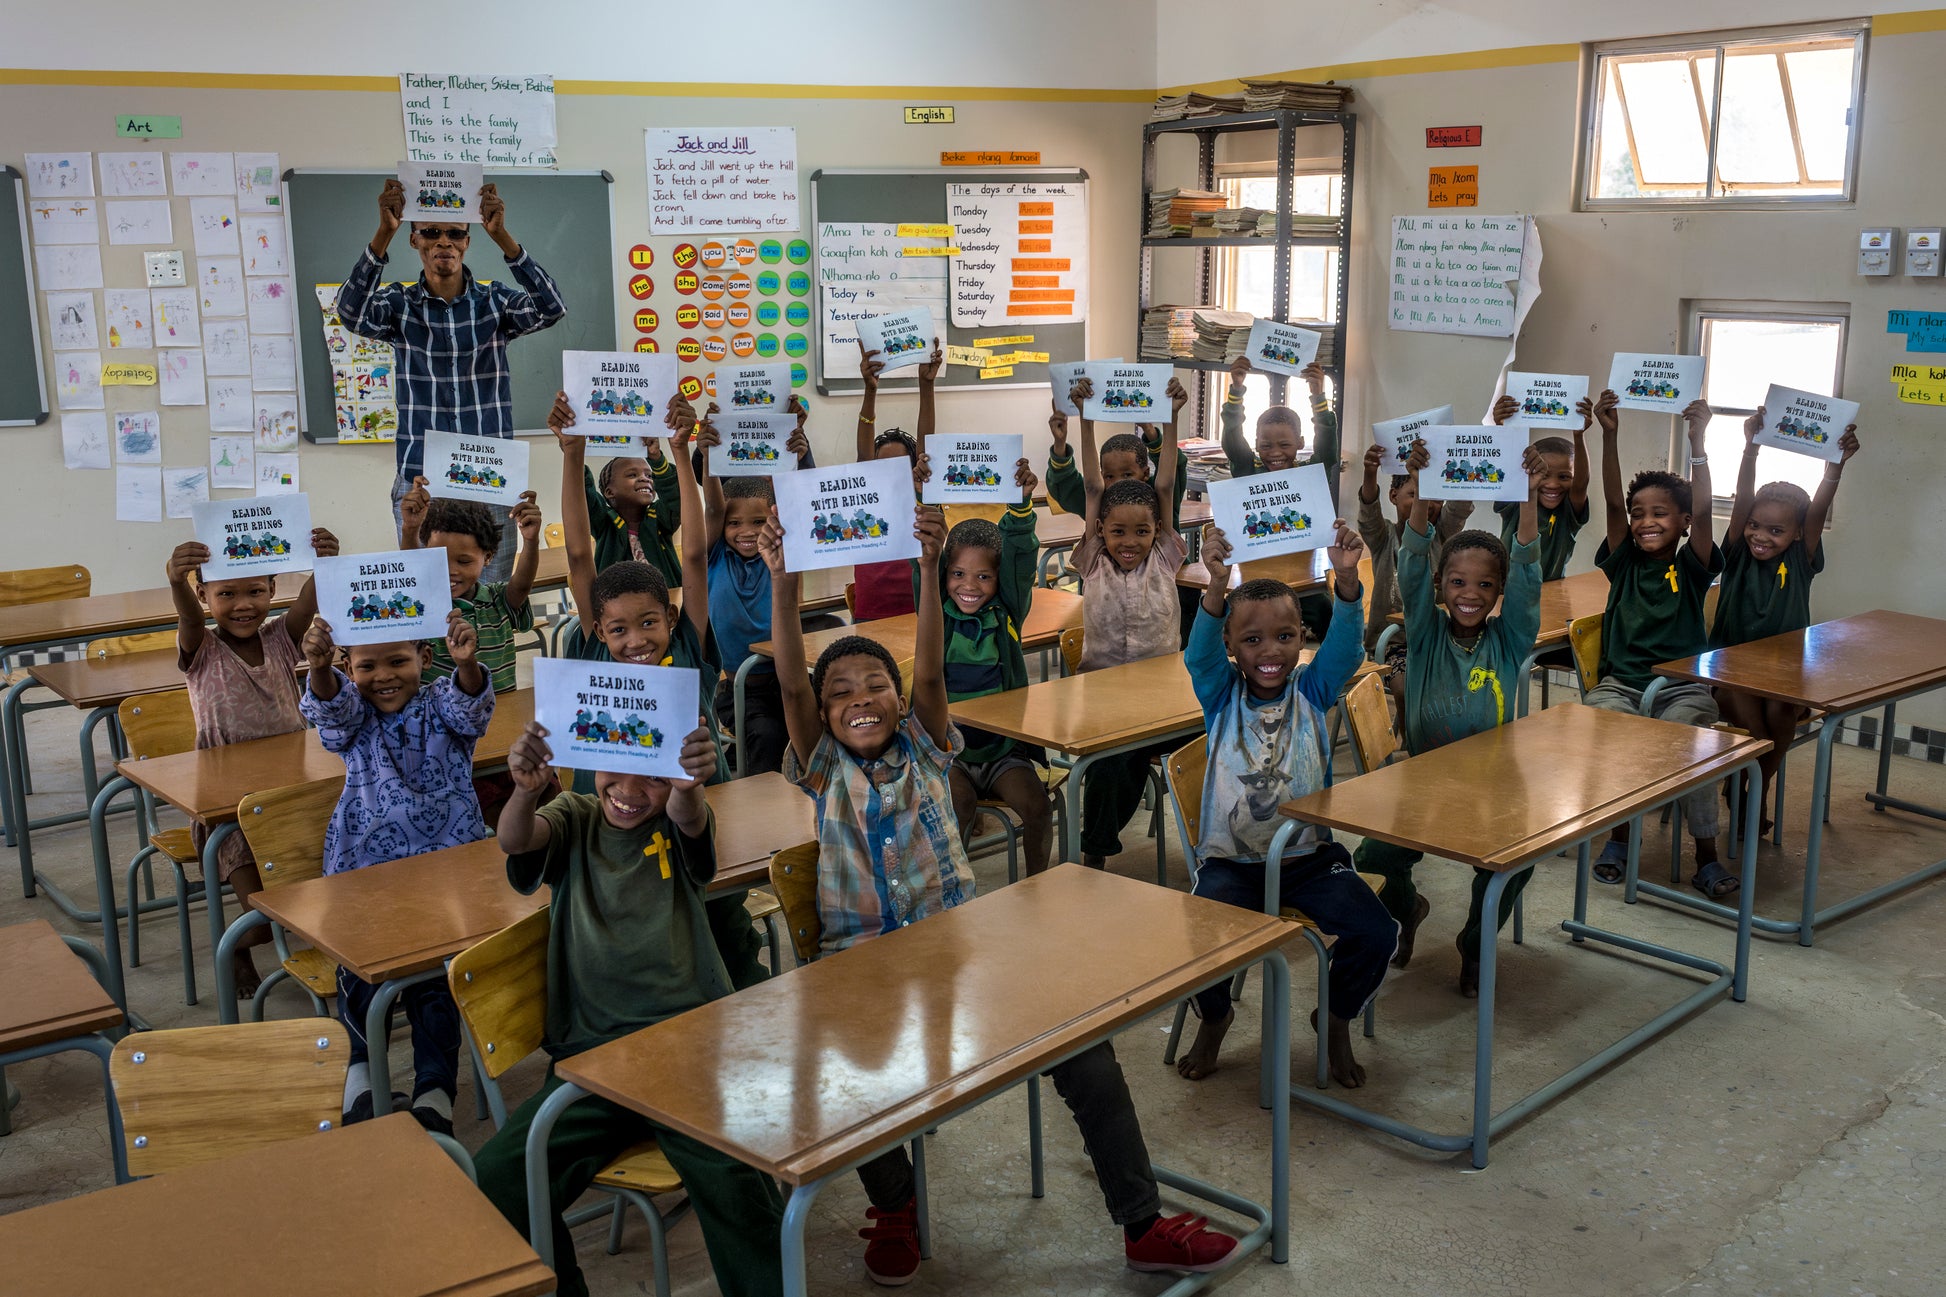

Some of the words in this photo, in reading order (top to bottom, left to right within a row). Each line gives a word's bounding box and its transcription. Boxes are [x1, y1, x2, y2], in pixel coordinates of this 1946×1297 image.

[406, 73, 445, 90] Father,
[448, 76, 487, 92] Mother,
[406, 96, 430, 108] and
[443, 97, 450, 109] I
[912, 108, 944, 123] English
[126, 120, 152, 132] Art
[408, 113, 432, 126] This
[442, 116, 452, 126] is
[460, 114, 482, 126] the
[489, 114, 518, 132] family
[409, 130, 435, 143] This
[444, 133, 454, 142] is
[461, 132, 482, 145] the
[490, 132, 522, 150] family
[677, 136, 704, 150] Jack
[708, 137, 728, 150] and
[732, 137, 748, 150] Jill
[1430, 130, 1462, 147] Religious
[410, 149, 436, 161] This
[444, 150, 453, 160] is
[460, 149, 480, 162] the
[488, 149, 516, 165] family
[522, 152, 532, 164] of
[652, 158, 675, 170] Jack
[679, 161, 695, 170] and
[701, 160, 714, 170] Jill
[720, 162, 742, 171] went
[744, 164, 754, 174] up
[760, 160, 774, 170] the
[780, 160, 794, 171] hill
[654, 174, 664, 185] To
[672, 174, 696, 185] fetch
[712, 175, 724, 188] pill
[730, 175, 740, 184] of
[653, 190, 675, 200] Jack
[684, 190, 697, 200] fell
[702, 190, 725, 200] down
[730, 190, 747, 200] and
[754, 192, 776, 200] broke
[783, 192, 796, 200] his
[952, 185, 970, 194] The
[981, 184, 1000, 198] days
[1006, 184, 1016, 194] of
[1022, 184, 1036, 194] the
[1429, 191, 1448, 202] Lets
[1456, 193, 1476, 206] pray
[954, 206, 988, 219] Monday
[654, 216, 674, 225] And
[681, 216, 694, 225] Jill
[727, 216, 762, 229] tumbling
[862, 225, 874, 236] he
[955, 224, 991, 236] Tuesday
[640, 252, 644, 262] I
[704, 249, 722, 260] you
[736, 246, 756, 256] your
[677, 251, 695, 266] the
[956, 260, 996, 273] Thursday
[635, 283, 648, 293] he
[678, 279, 695, 287] she
[790, 279, 806, 288] old
[958, 277, 984, 288] Friday
[829, 287, 858, 303] Today
[867, 290, 874, 298] is
[958, 292, 994, 303] Saturday
[639, 316, 654, 324] me
[679, 311, 696, 319] are
[705, 310, 721, 319] said
[731, 310, 748, 318] here
[958, 307, 986, 320] Sunday
[1890, 312, 1908, 326] Mi
[734, 340, 752, 349] they
[1912, 331, 1925, 346] My
[704, 343, 724, 352] there
[602, 362, 640, 372] READING
[683, 384, 696, 395] to
[1900, 386, 1930, 400] Lets
[956, 442, 990, 450] READING
[1456, 435, 1492, 444] READING
[460, 442, 495, 454] READING
[820, 476, 866, 492] READING
[1249, 480, 1289, 496] READING
[811, 498, 839, 511] WITH
[232, 506, 272, 518] READING
[360, 562, 404, 576] READING
[350, 580, 378, 592] WITH
[590, 675, 645, 691] READING
[577, 692, 608, 706] WITH
